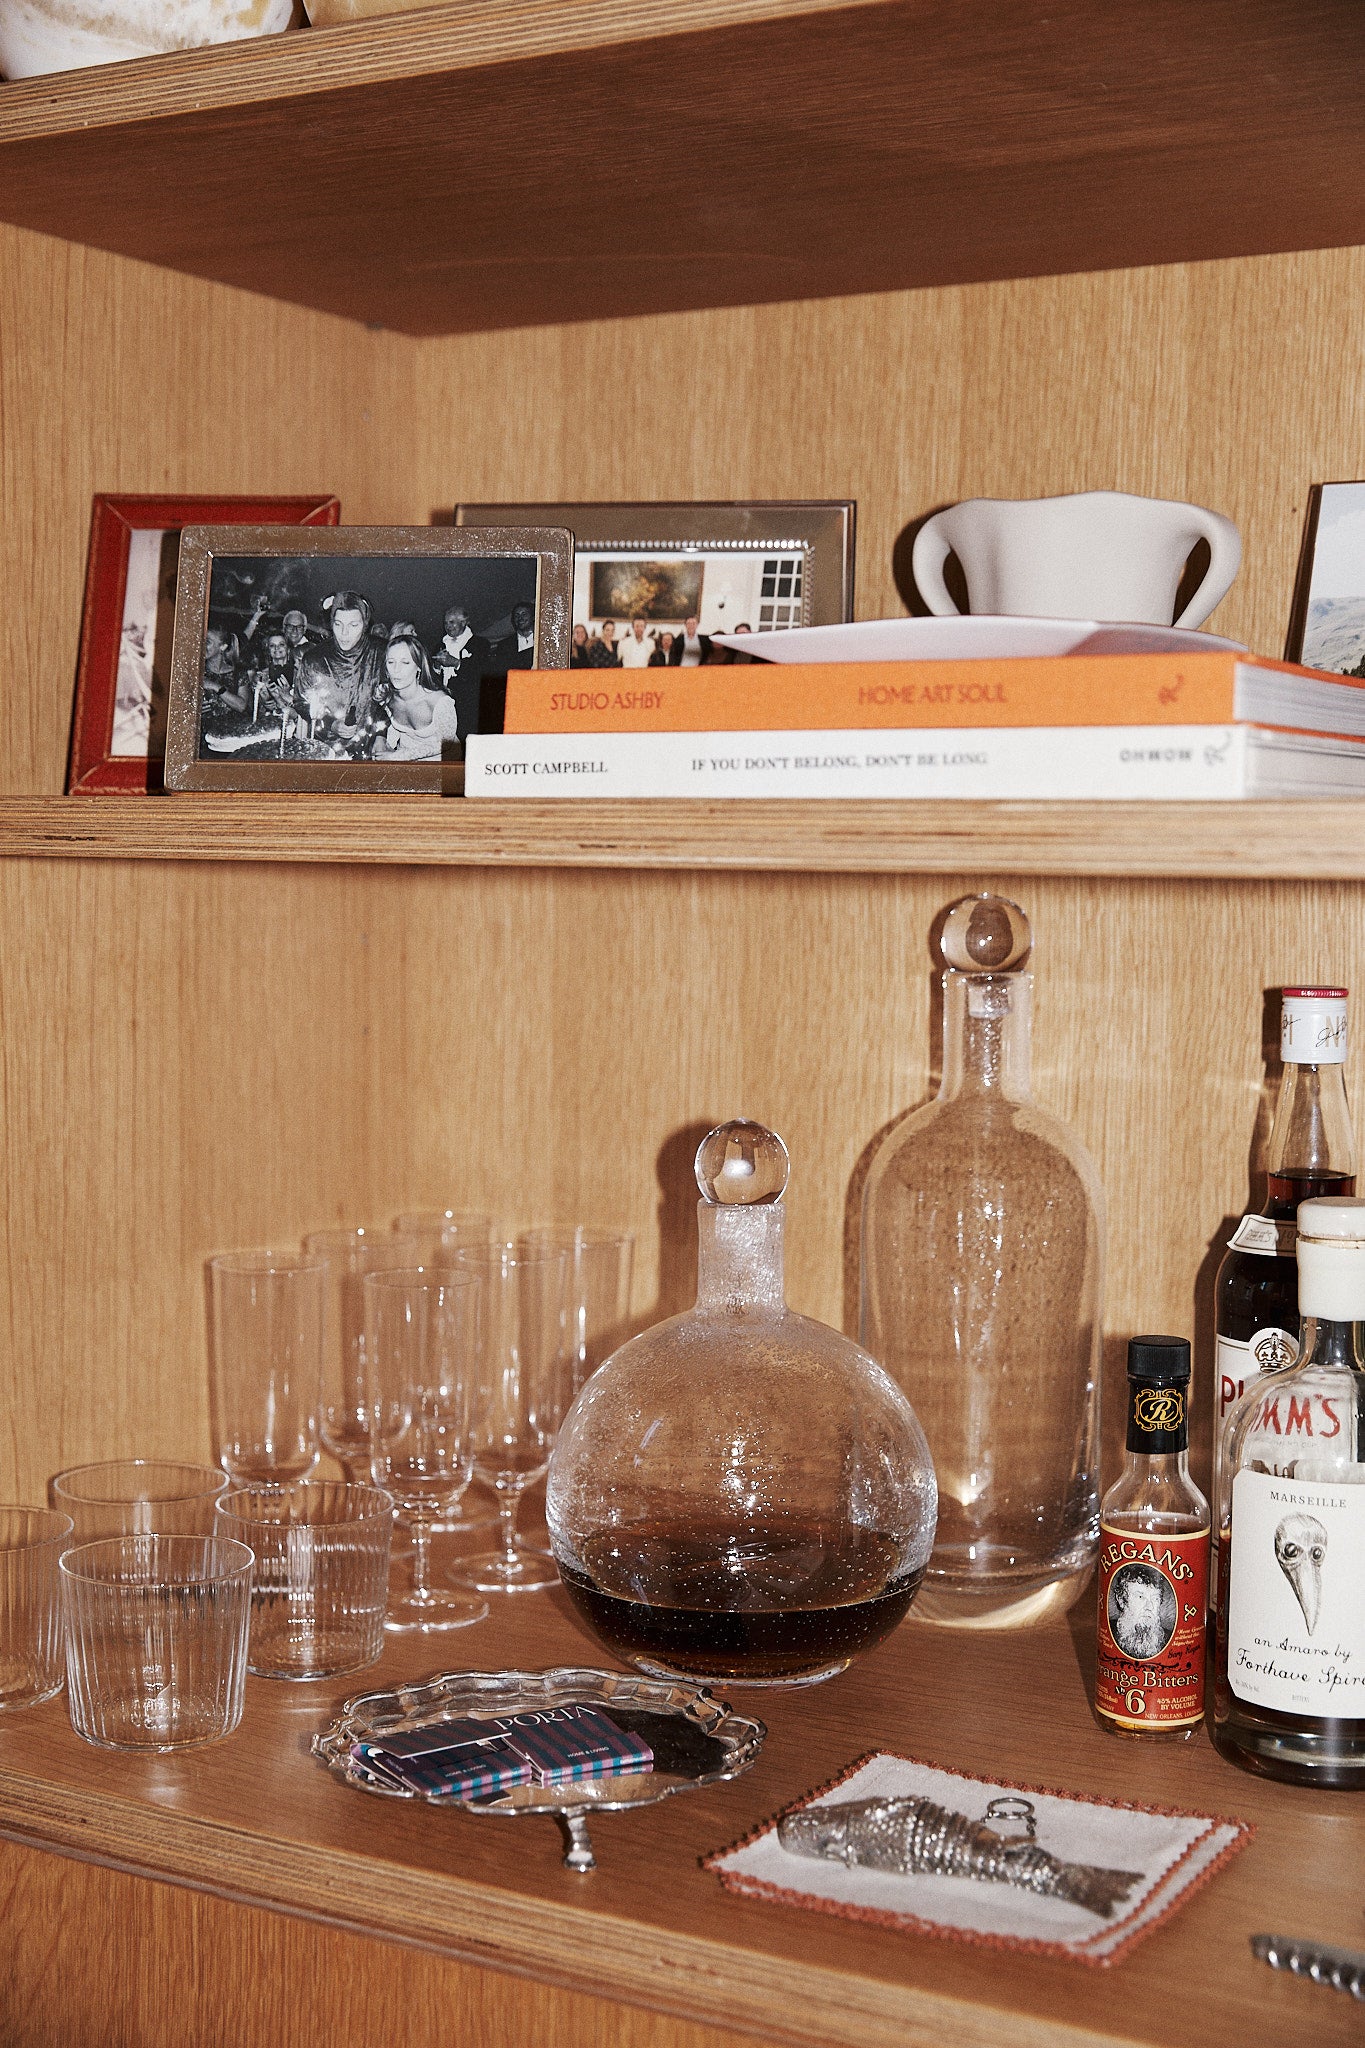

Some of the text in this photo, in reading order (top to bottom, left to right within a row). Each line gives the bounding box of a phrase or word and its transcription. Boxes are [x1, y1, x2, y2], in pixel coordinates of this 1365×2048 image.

[550, 691, 664, 710] STUDIO ASHBY
[858, 682, 1007, 705] HOME ART SOUL
[484, 761, 608, 775] SCOTT CAMPBELL
[692, 759, 705, 771] IF
[710, 758, 740, 770] YOU
[745, 757, 789, 769] DON'T
[917, 753, 936, 766] BE
[943, 752, 988, 765] LONG
[1270, 1490, 1348, 1508] MARSEILLE
[1254, 1637, 1353, 1664] an Amaro by
[1236, 1647, 1310, 1683] Forthave
[1100, 1665, 1199, 1689] range Bitters
[1170, 1700, 1196, 1711] VOLUME
[1171, 1693, 1199, 1705] ALCOHOL
[493, 1705, 598, 1730] PORTA
